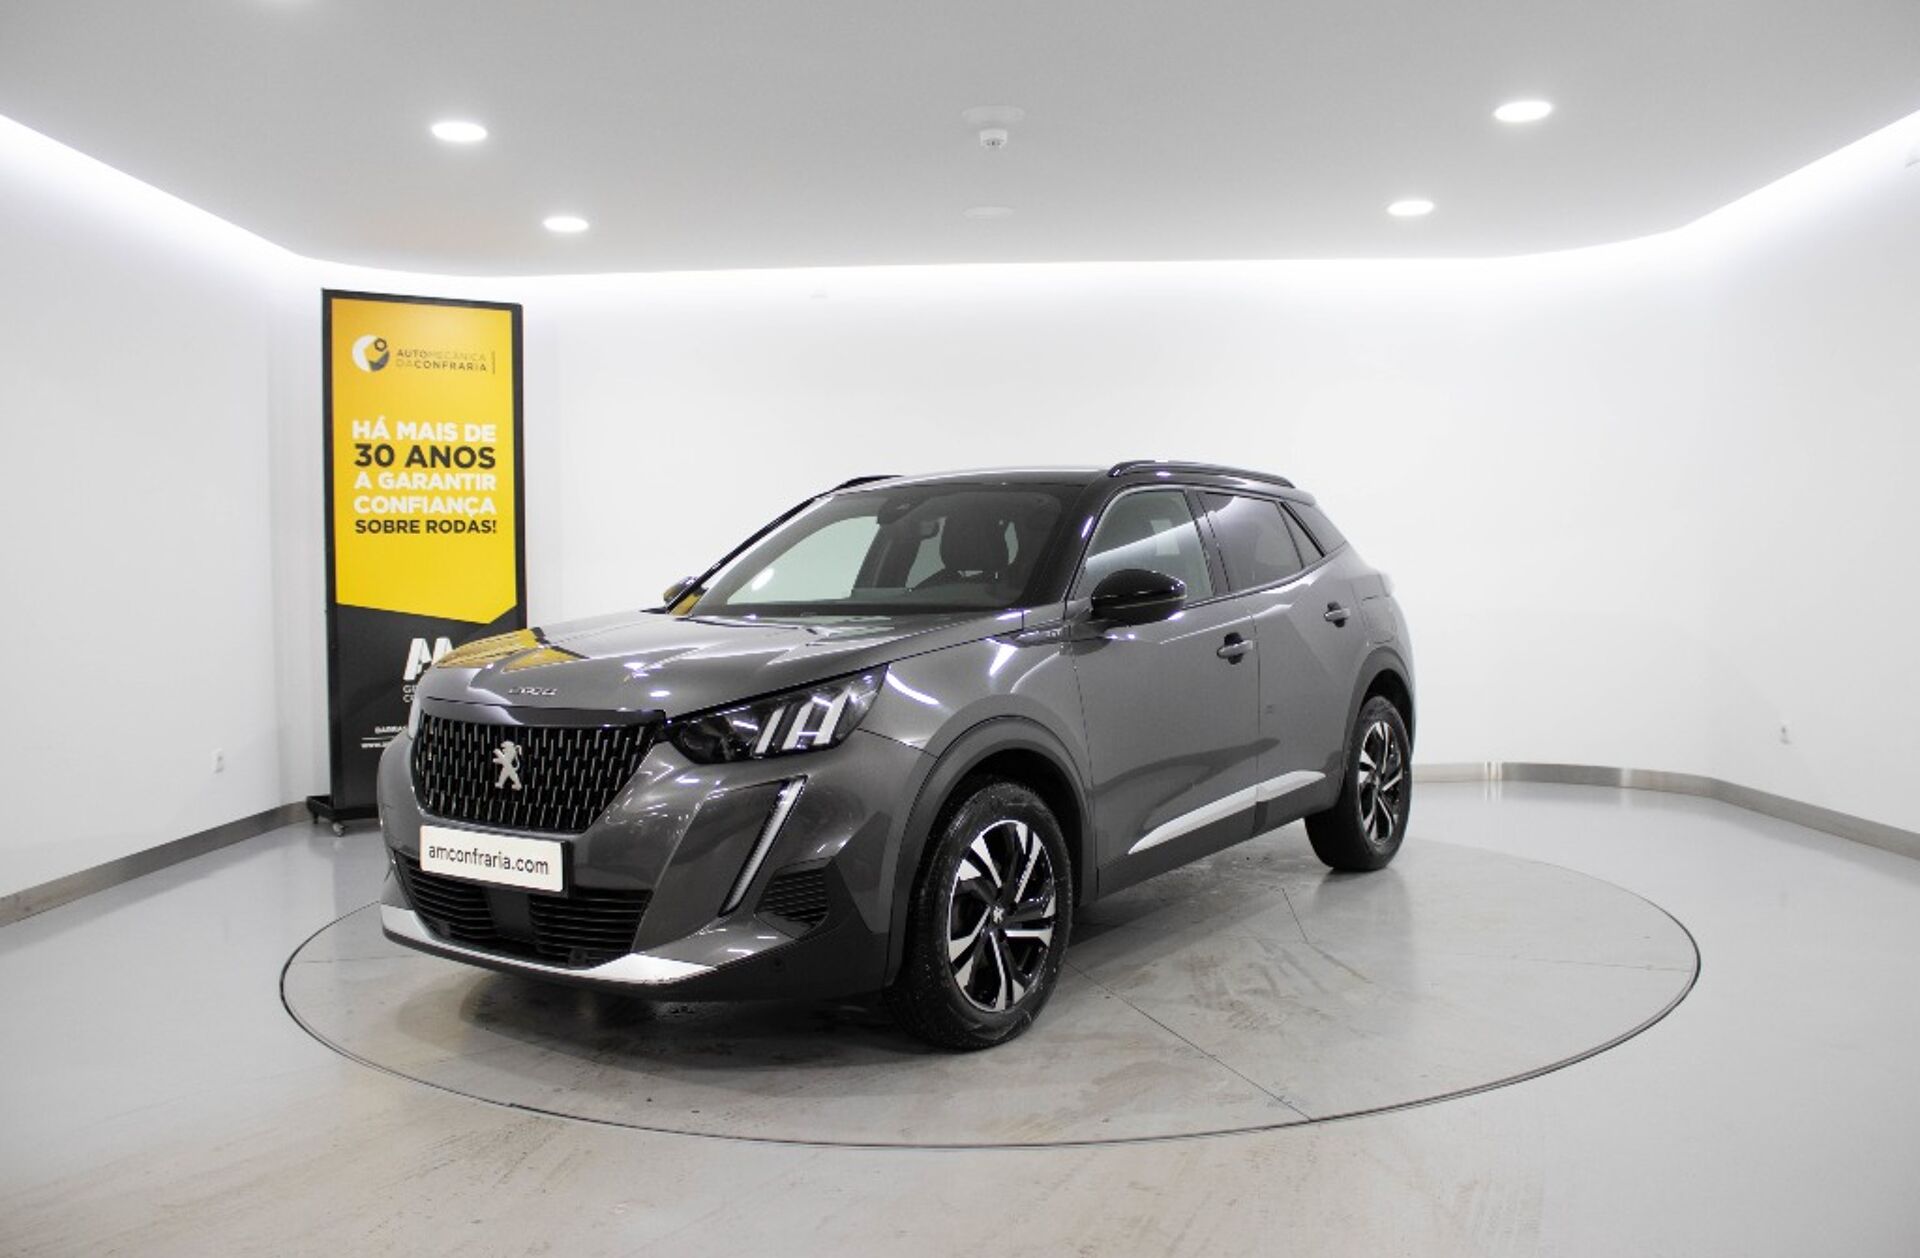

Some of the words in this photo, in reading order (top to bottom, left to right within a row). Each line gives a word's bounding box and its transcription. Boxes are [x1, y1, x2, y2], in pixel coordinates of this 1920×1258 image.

[352, 415, 391, 440] HÁ
[396, 421, 458, 442] MAIS
[464, 423, 496, 443] DE
[354, 443, 395, 468] 30
[404, 444, 496, 469] ANOS
[354, 471, 373, 489] A
[378, 472, 496, 491] GARANTIR
[353, 495, 497, 518] CONFIANÇA
[355, 519, 421, 534] SOBRE
[426, 519, 497, 535] RODAS!
[428, 845, 550, 875] amconfraria.com
